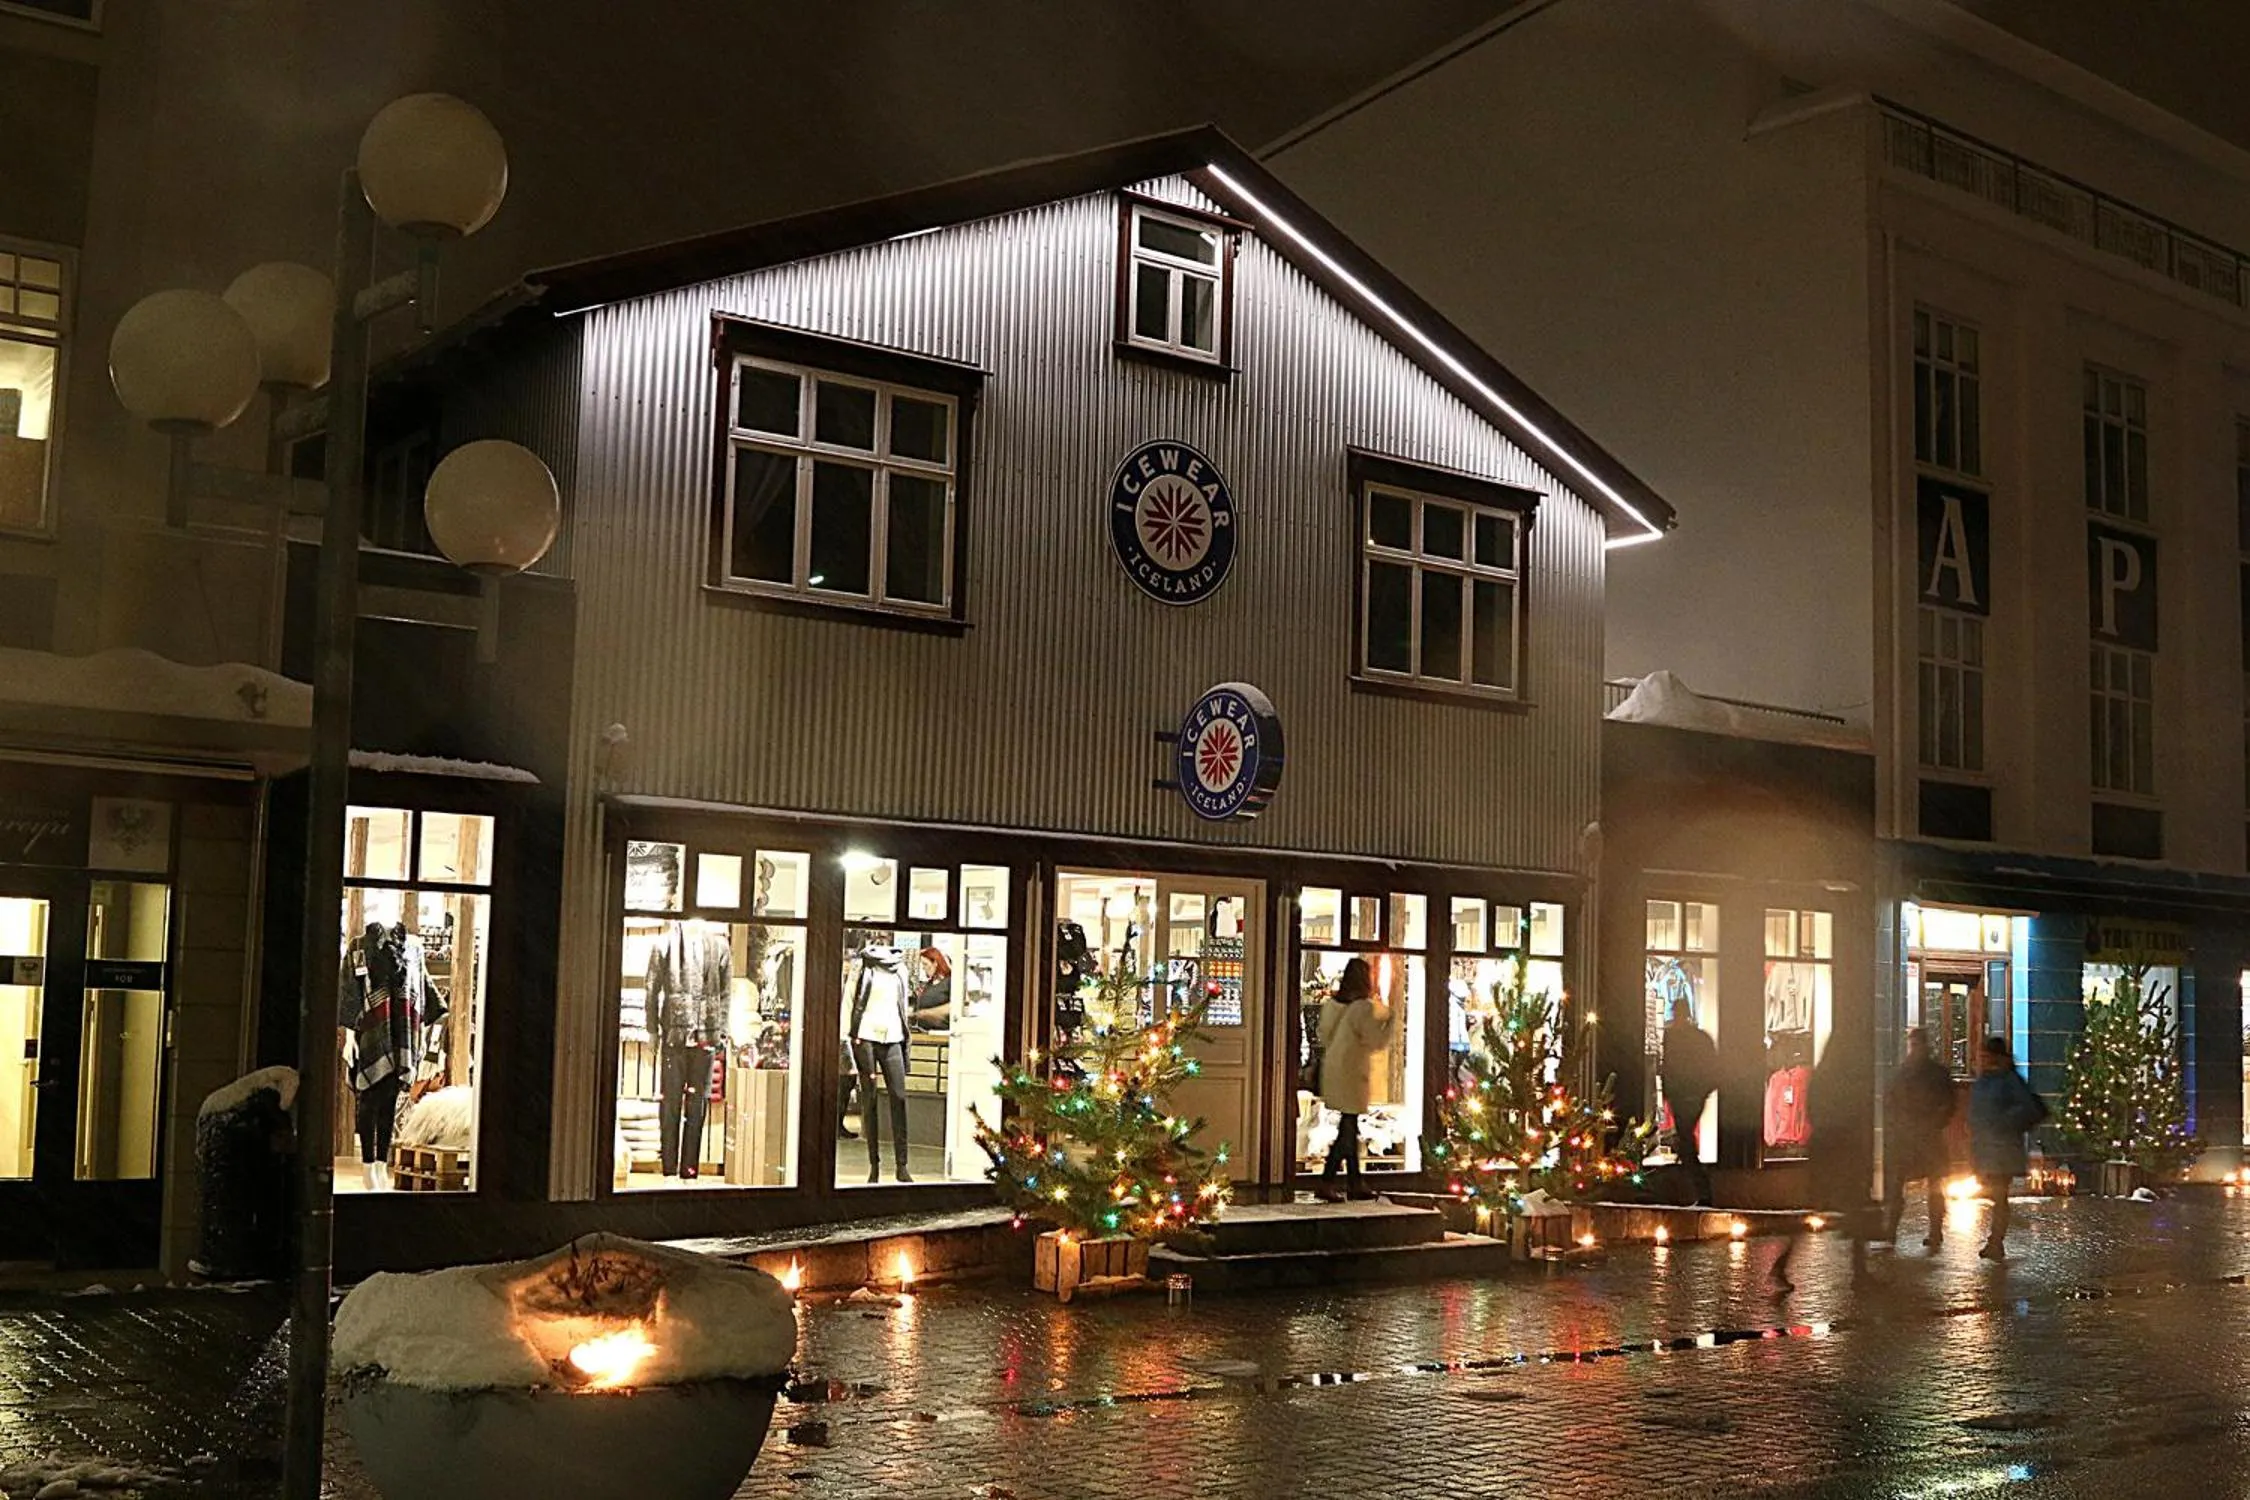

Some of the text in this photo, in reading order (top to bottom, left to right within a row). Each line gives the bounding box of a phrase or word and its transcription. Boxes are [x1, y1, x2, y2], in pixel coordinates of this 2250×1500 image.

[1115, 448, 1230, 529] ICEWEAR
[1128, 553, 1214, 594] ICELAND
[1182, 698, 1255, 757] ICEWEAR
[1191, 781, 1245, 811] ICELAND
